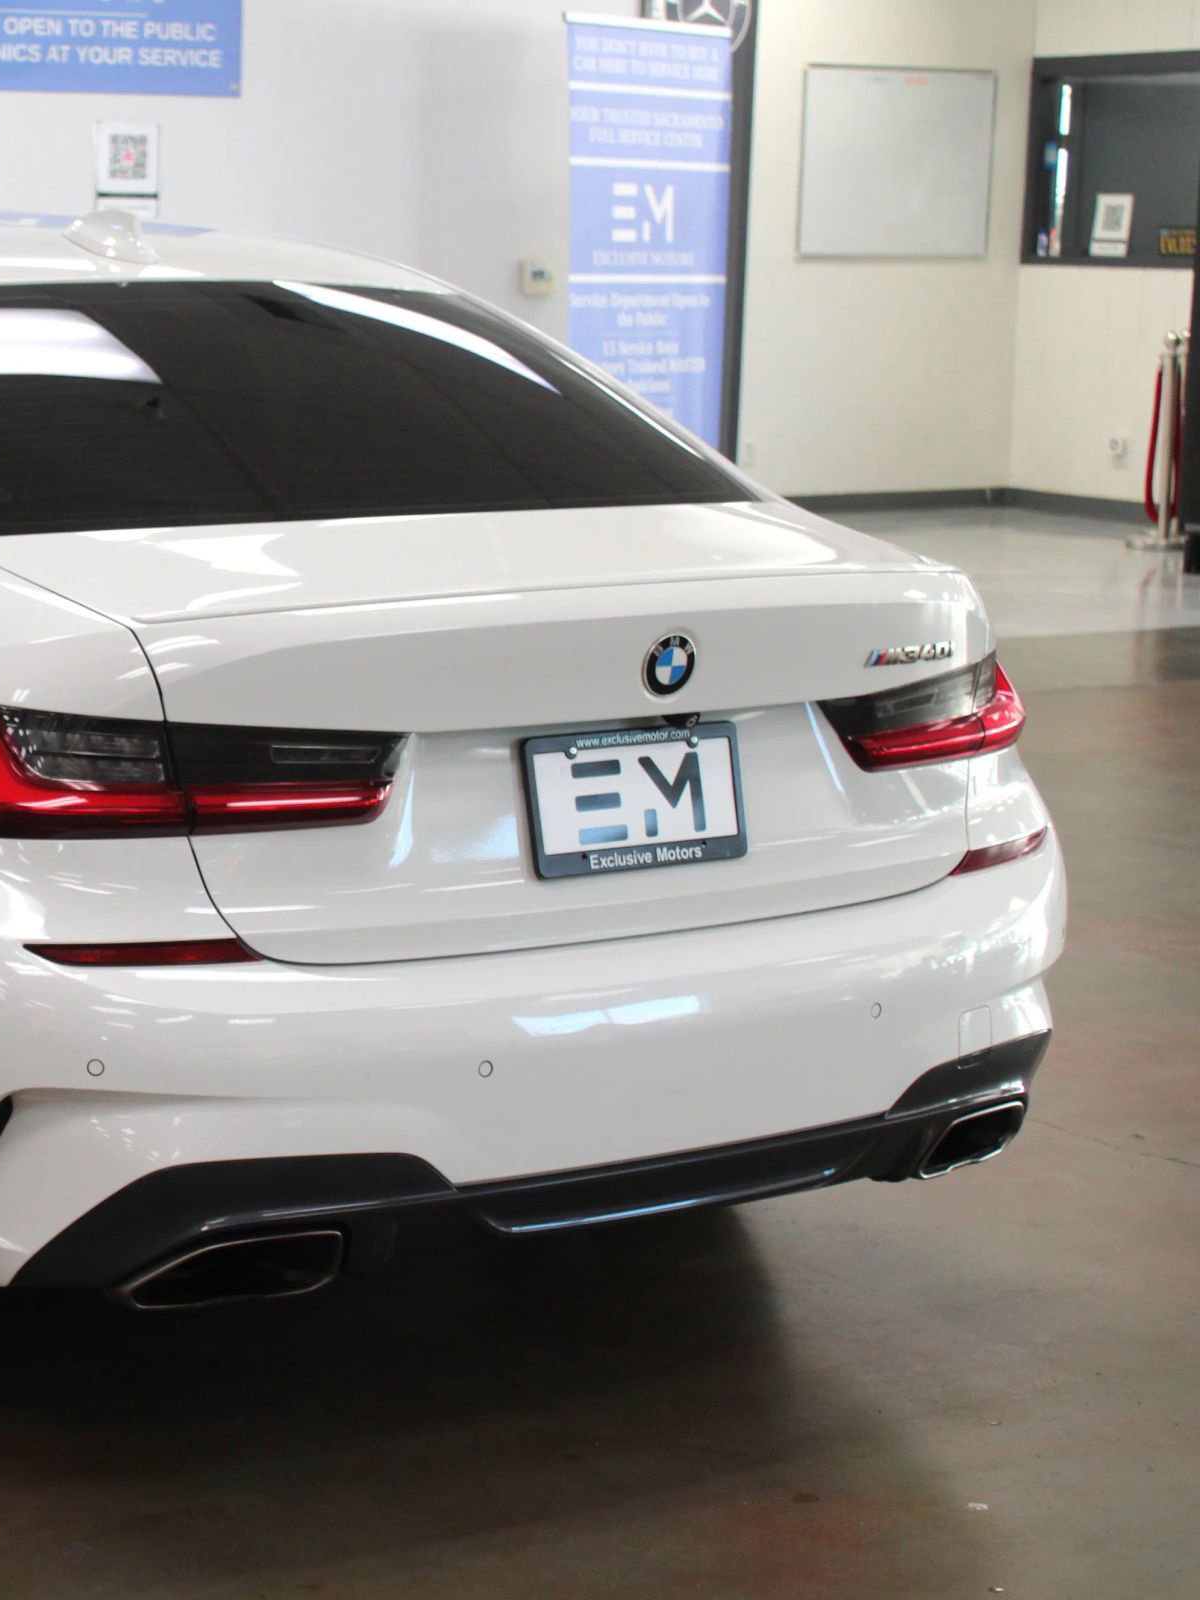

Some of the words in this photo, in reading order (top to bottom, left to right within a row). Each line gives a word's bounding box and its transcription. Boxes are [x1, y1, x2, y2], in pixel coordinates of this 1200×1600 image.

[3, 17, 62, 37] OPEN
[67, 18, 96, 38] TO
[100, 19, 140, 40] THE
[144, 21, 217, 42] PUBLIC
[46, 44, 71, 64] AT
[76, 46, 134, 66] YOUR
[138, 47, 223, 69] SERVICE
[611, 182, 676, 243] EM
[652, 635, 694, 657] BMW
[576, 728, 691, 748] www.exclusivemotor.com
[571, 751, 707, 845] EM
[589, 848, 653, 870] Exclusive
[656, 845, 703, 862] Motors
